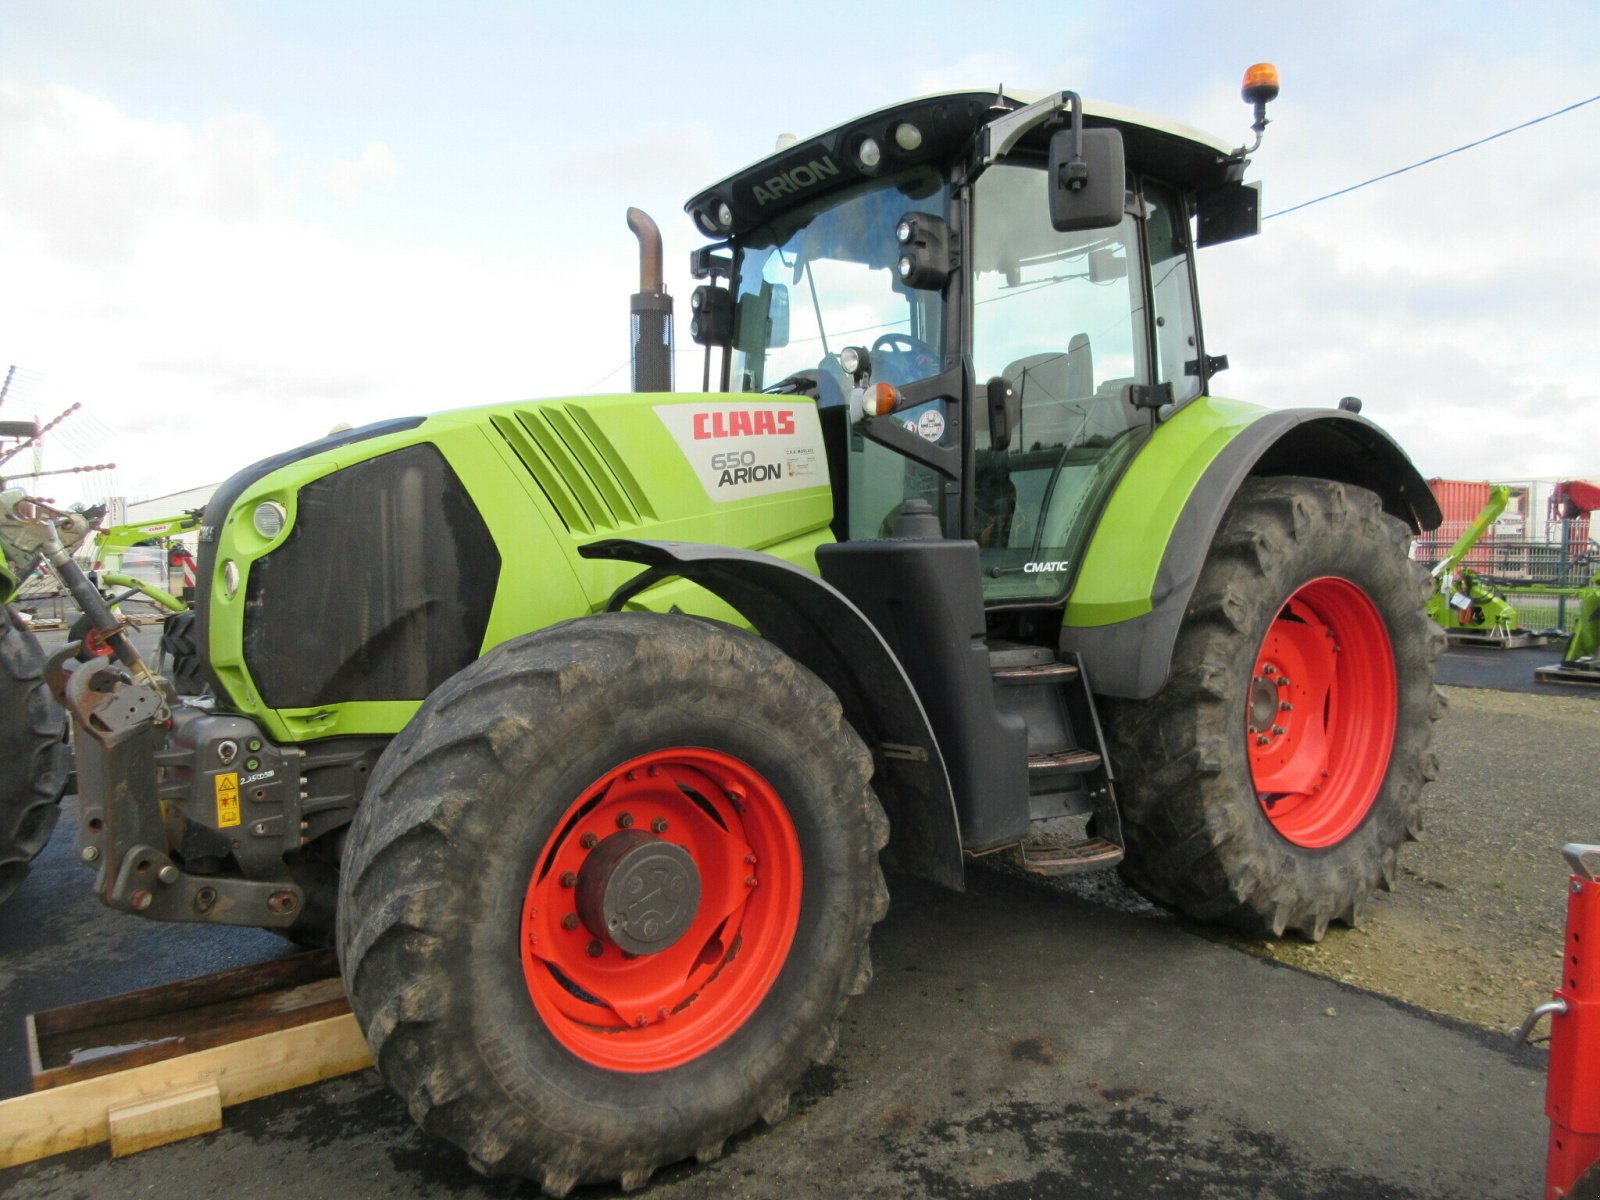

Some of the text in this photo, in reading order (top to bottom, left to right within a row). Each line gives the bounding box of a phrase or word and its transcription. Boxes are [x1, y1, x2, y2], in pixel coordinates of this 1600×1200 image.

[752, 155, 840, 206] ARION
[693, 410, 795, 440] CLAAS
[711, 450, 756, 471] 650
[718, 463, 781, 488] ARION
[1023, 561, 1069, 573] CMATIC
